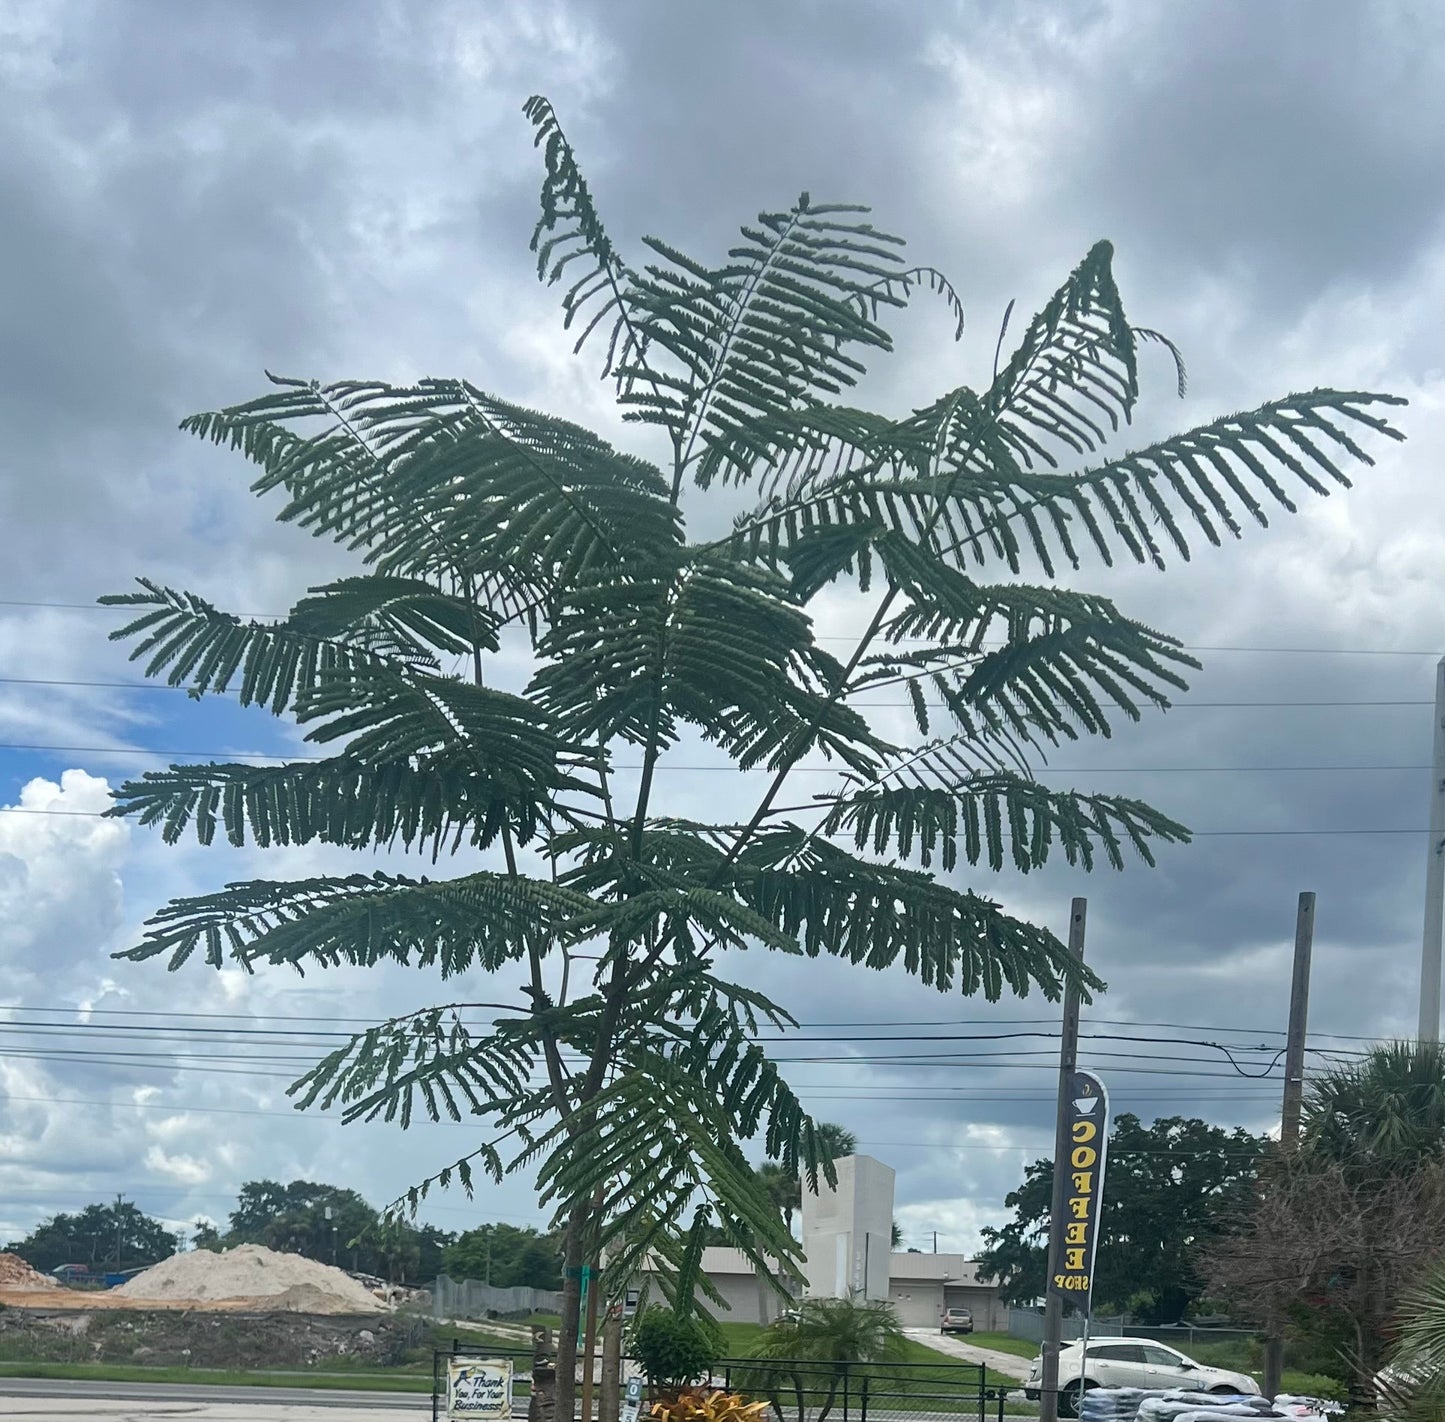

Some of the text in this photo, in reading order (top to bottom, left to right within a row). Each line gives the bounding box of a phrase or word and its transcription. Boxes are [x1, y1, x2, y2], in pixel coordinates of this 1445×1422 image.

[473, 1375, 504, 1388] Thank
[455, 1388, 504, 1400] You, For Your
[454, 1399, 504, 1411] Business!
